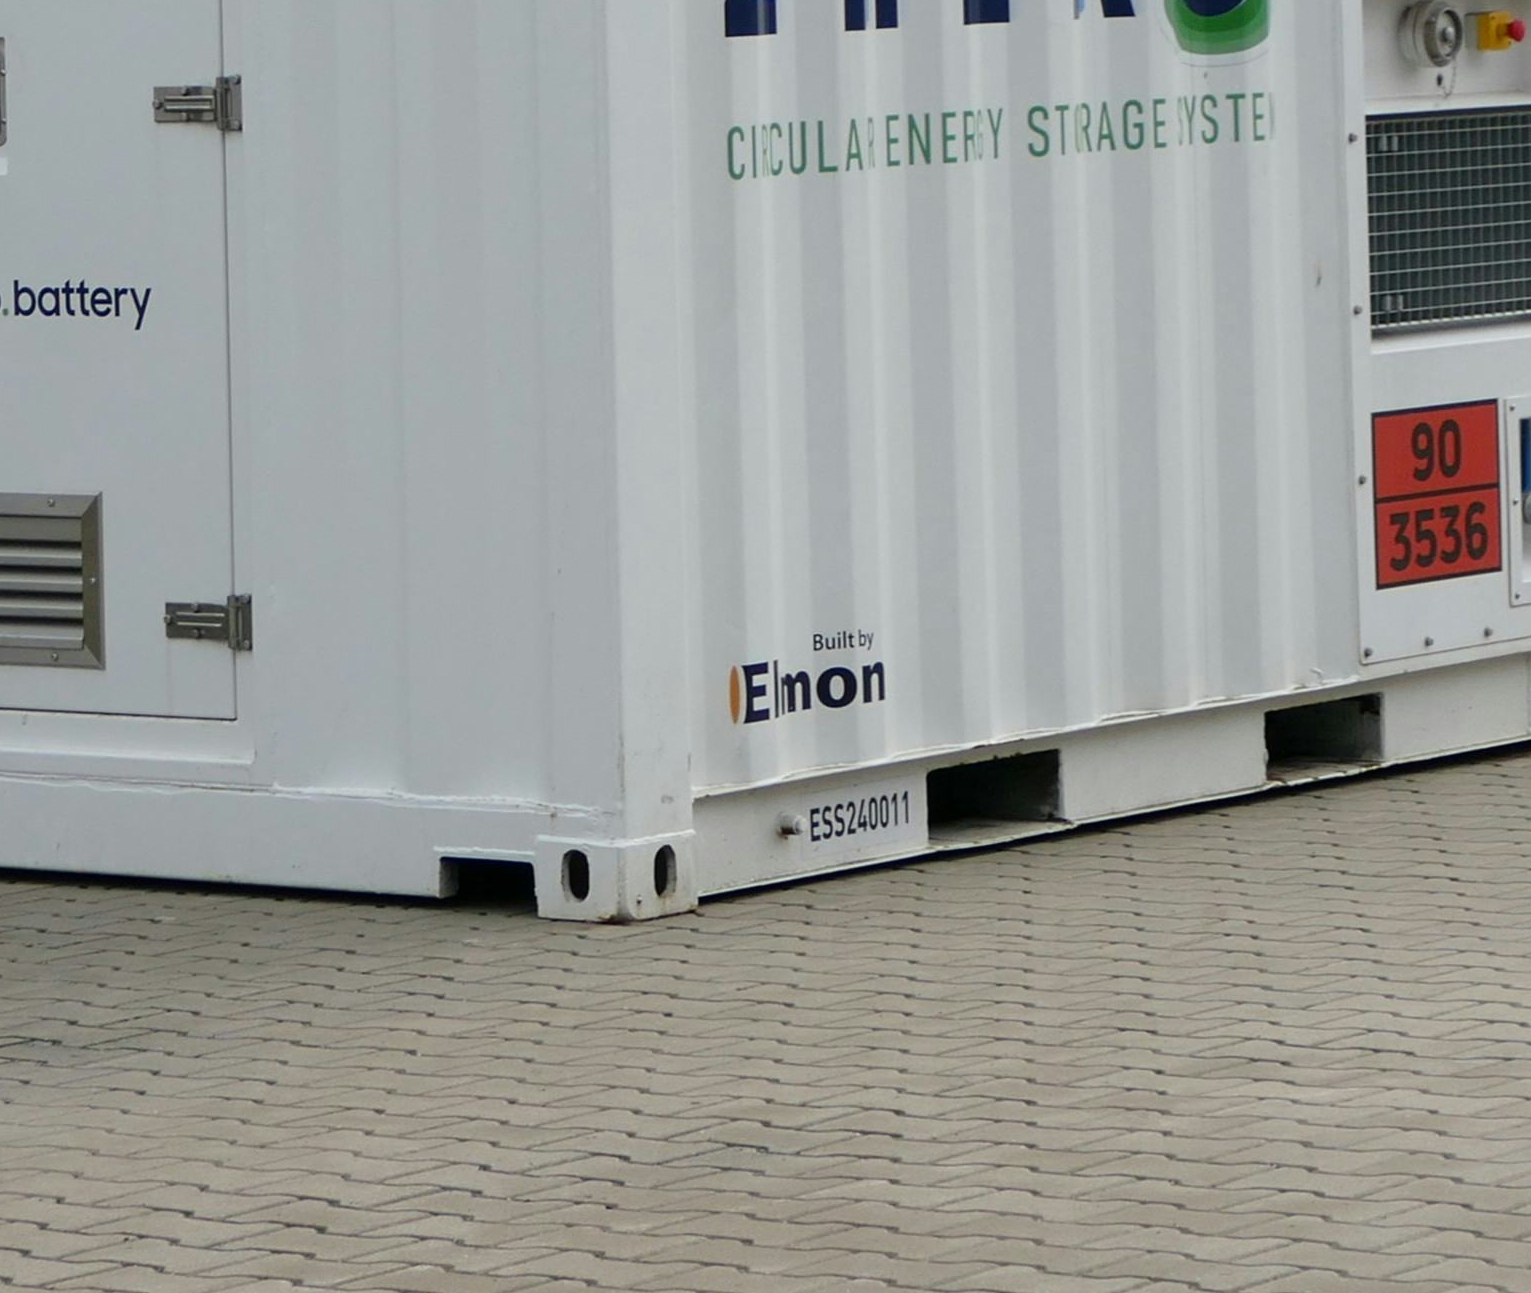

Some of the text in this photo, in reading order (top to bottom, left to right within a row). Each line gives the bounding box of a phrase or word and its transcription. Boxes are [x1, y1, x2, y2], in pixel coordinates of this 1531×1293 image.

[727, 117, 875, 181] CIRCULAR
[1177, 92, 1275, 146] SYSTE
[1412, 419, 1462, 482] 90
[1389, 501, 1489, 572] 3536
[813, 629, 874, 651] Built by
[741, 660, 886, 724] Elmon
[810, 790, 910, 842] ESS240011
